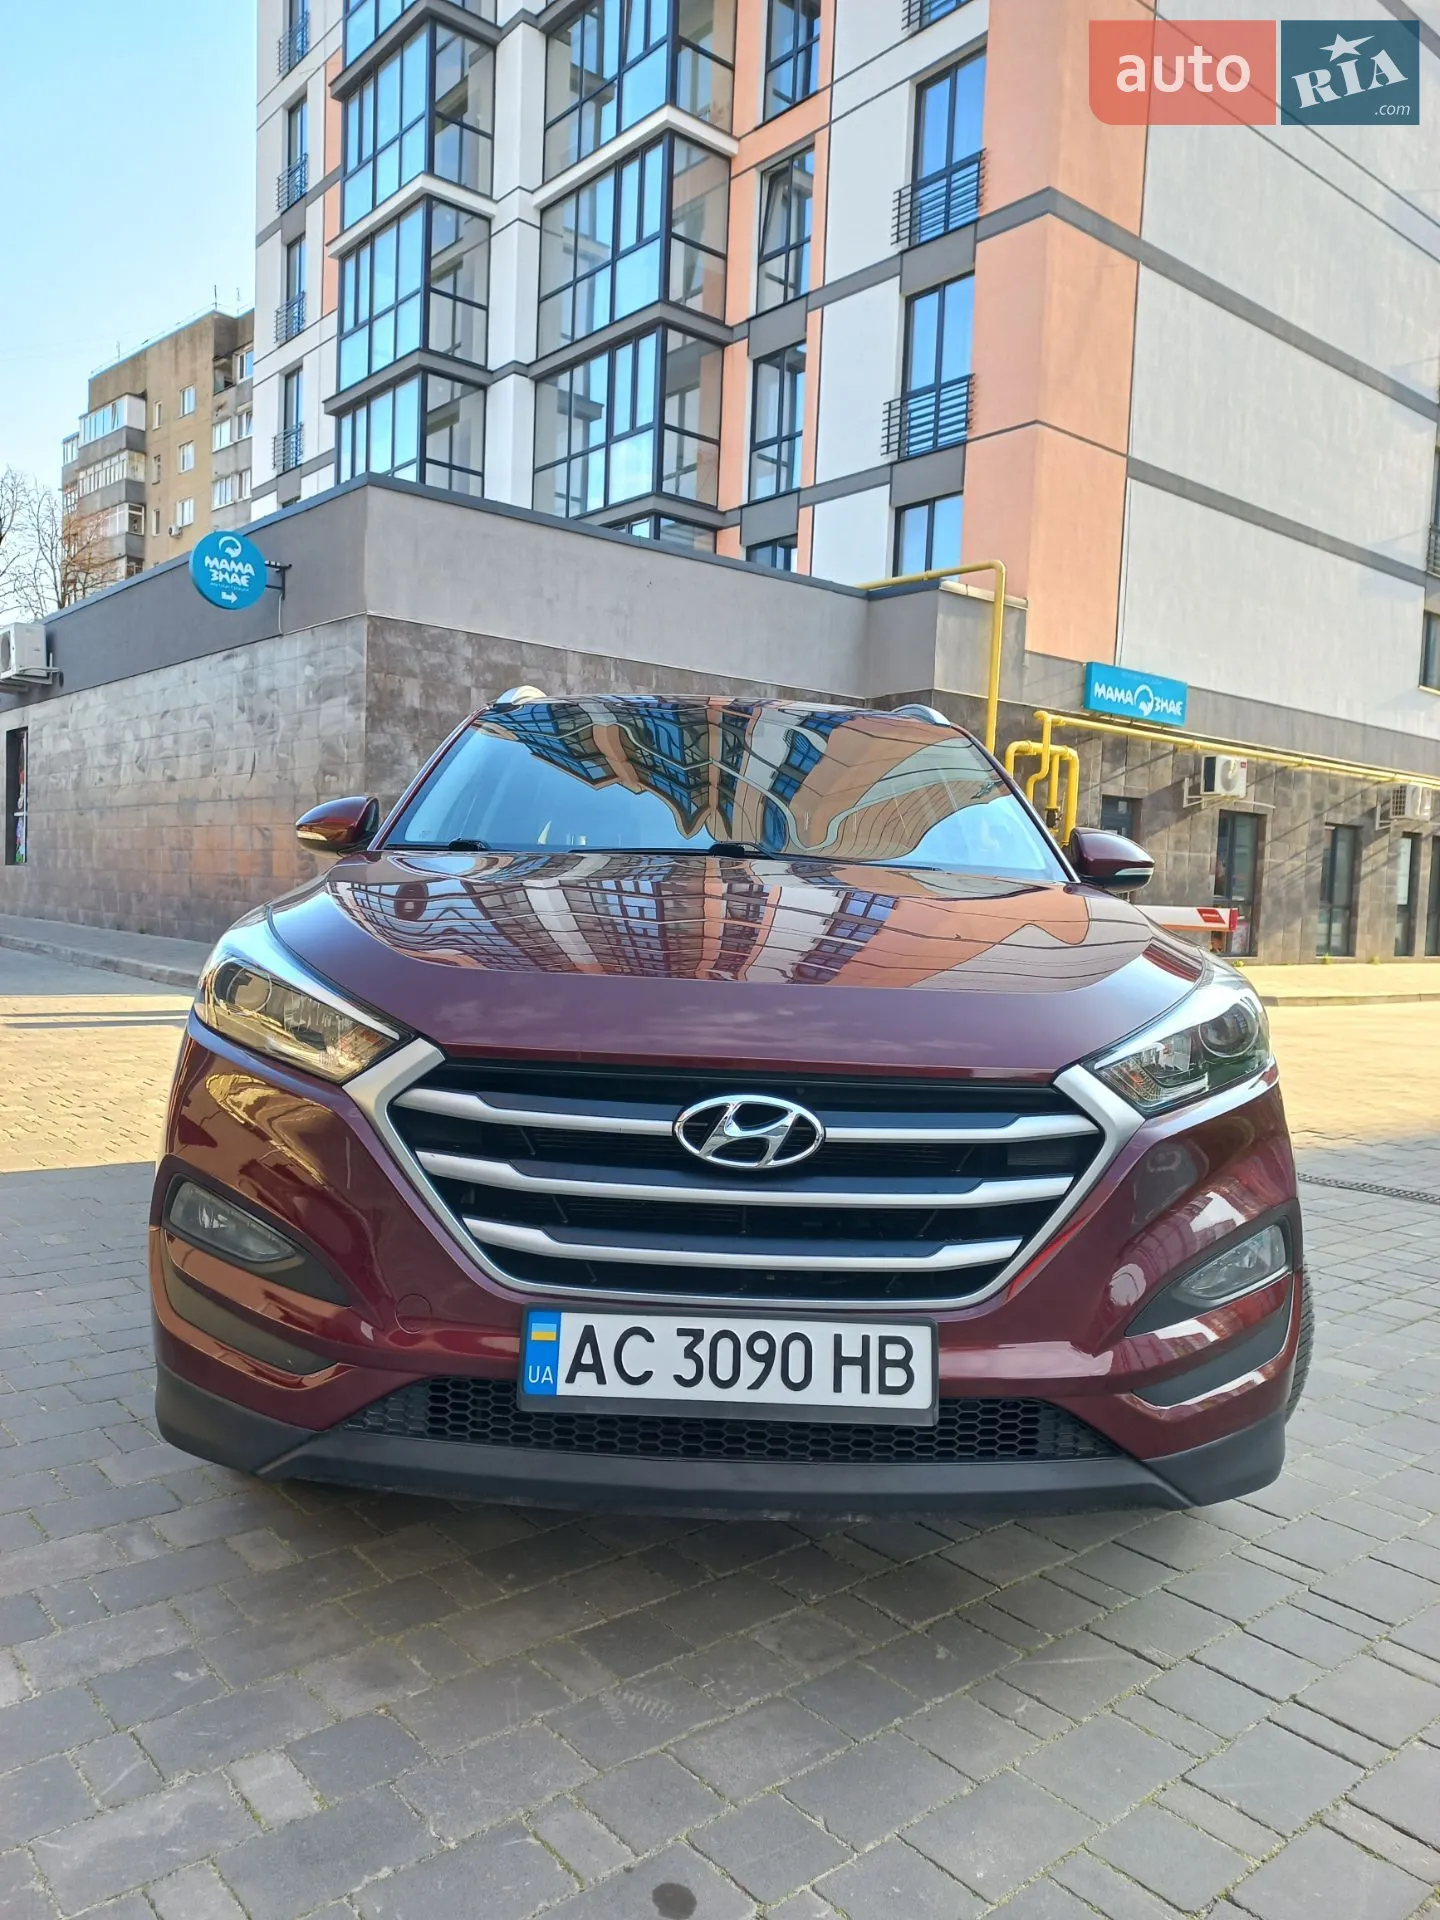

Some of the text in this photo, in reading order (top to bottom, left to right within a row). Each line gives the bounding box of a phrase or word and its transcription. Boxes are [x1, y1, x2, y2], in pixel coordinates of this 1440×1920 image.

[204, 555, 255, 577] МАМА
[1093, 682, 1134, 706] МАМА
[564, 1324, 915, 1395] AC 3090 HB
[528, 1365, 554, 1385] UA
